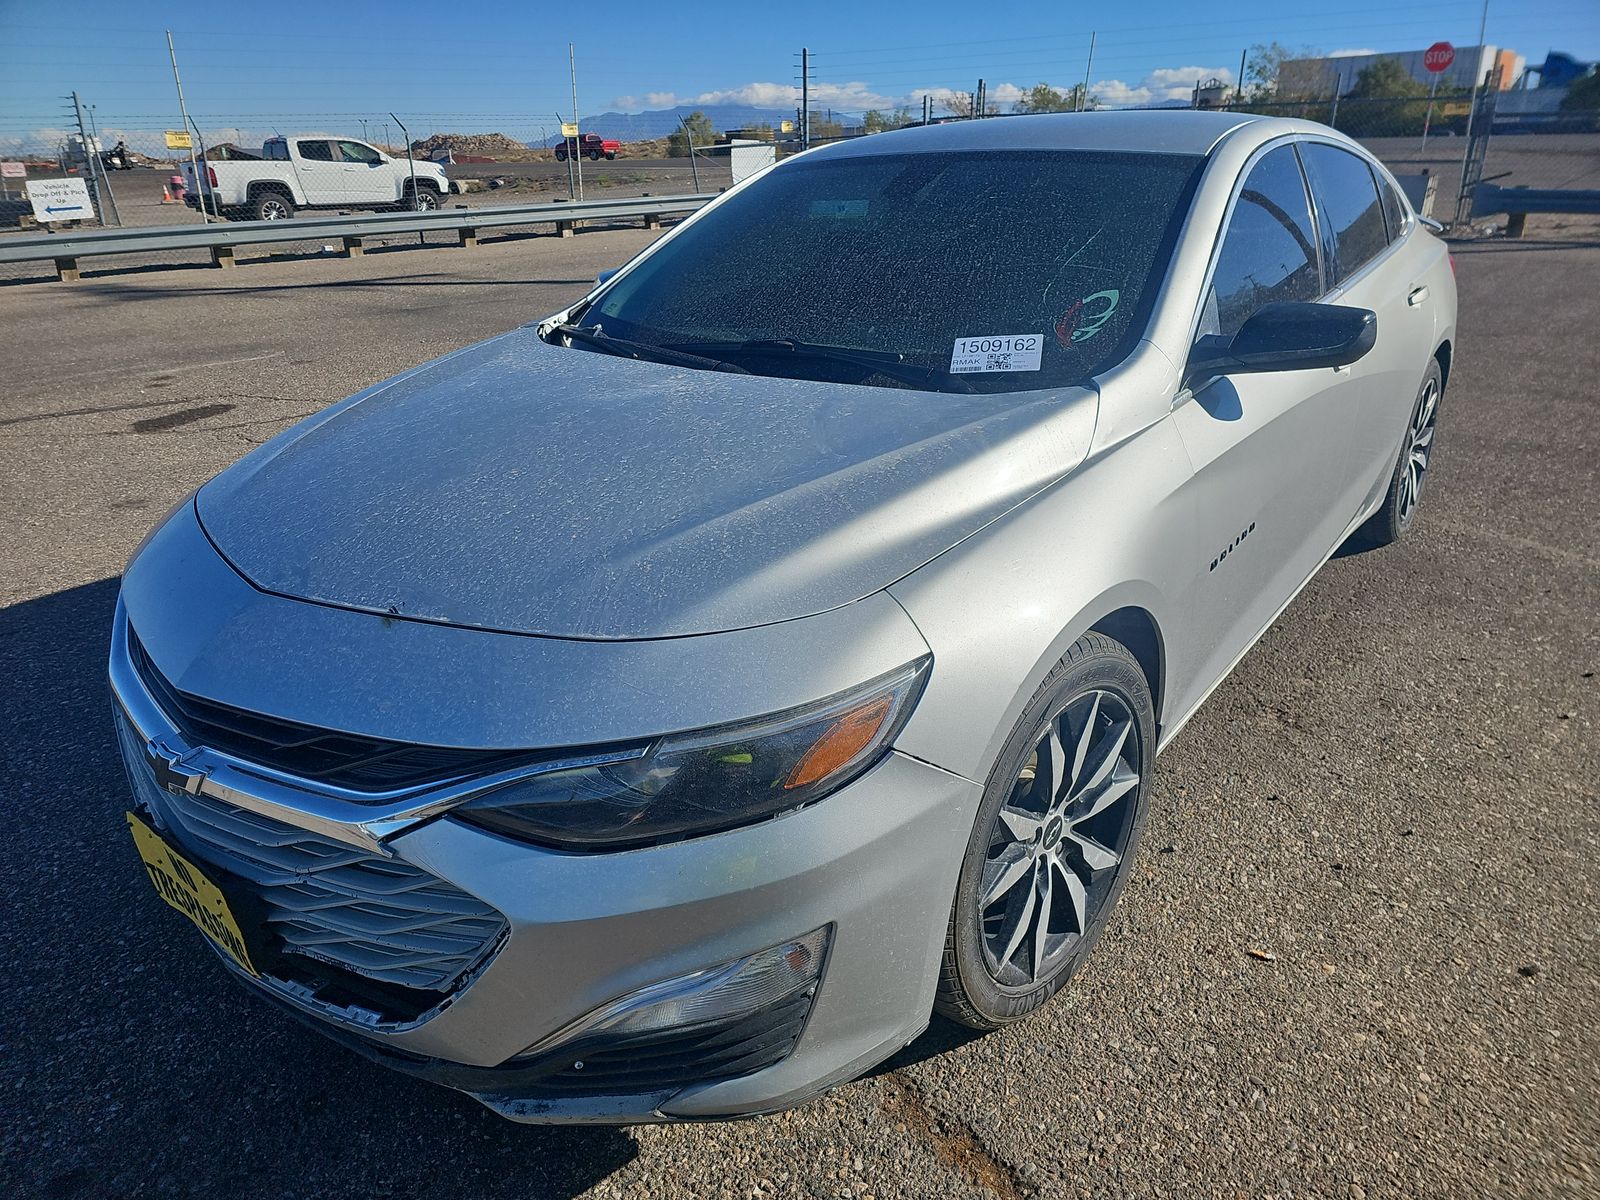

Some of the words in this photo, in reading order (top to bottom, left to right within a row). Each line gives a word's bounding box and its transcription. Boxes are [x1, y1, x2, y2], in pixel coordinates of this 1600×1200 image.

[1426, 51, 1453, 64] STOP
[960, 338, 1036, 353] 1509162
[163, 847, 198, 893] NO
[145, 861, 254, 974] TRESPASSING
[1006, 979, 1056, 1017] KENDA
